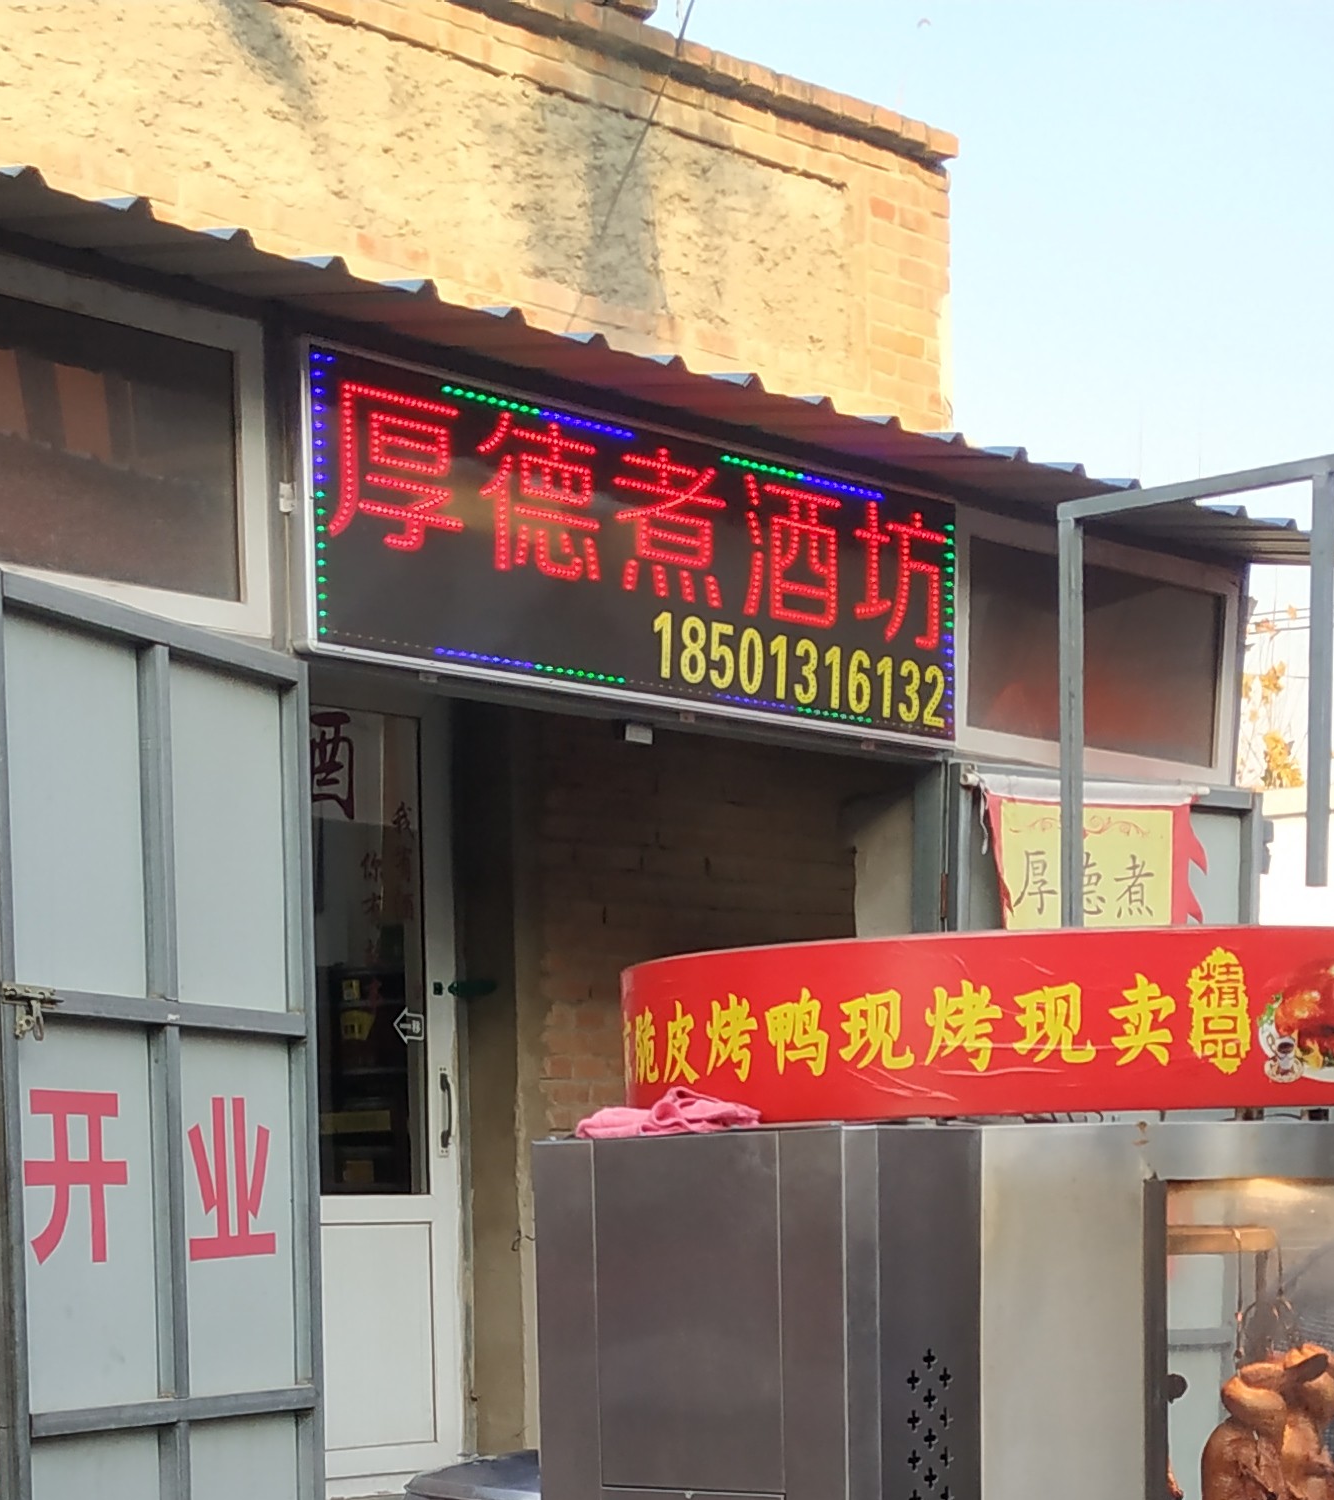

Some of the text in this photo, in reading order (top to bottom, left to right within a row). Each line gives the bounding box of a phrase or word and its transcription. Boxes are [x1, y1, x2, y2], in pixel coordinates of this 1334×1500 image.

[329, 380, 949, 649] 厚德煮酒坊
[652, 611, 946, 729] 18501316132
[23, 1088, 277, 1266] 开业
